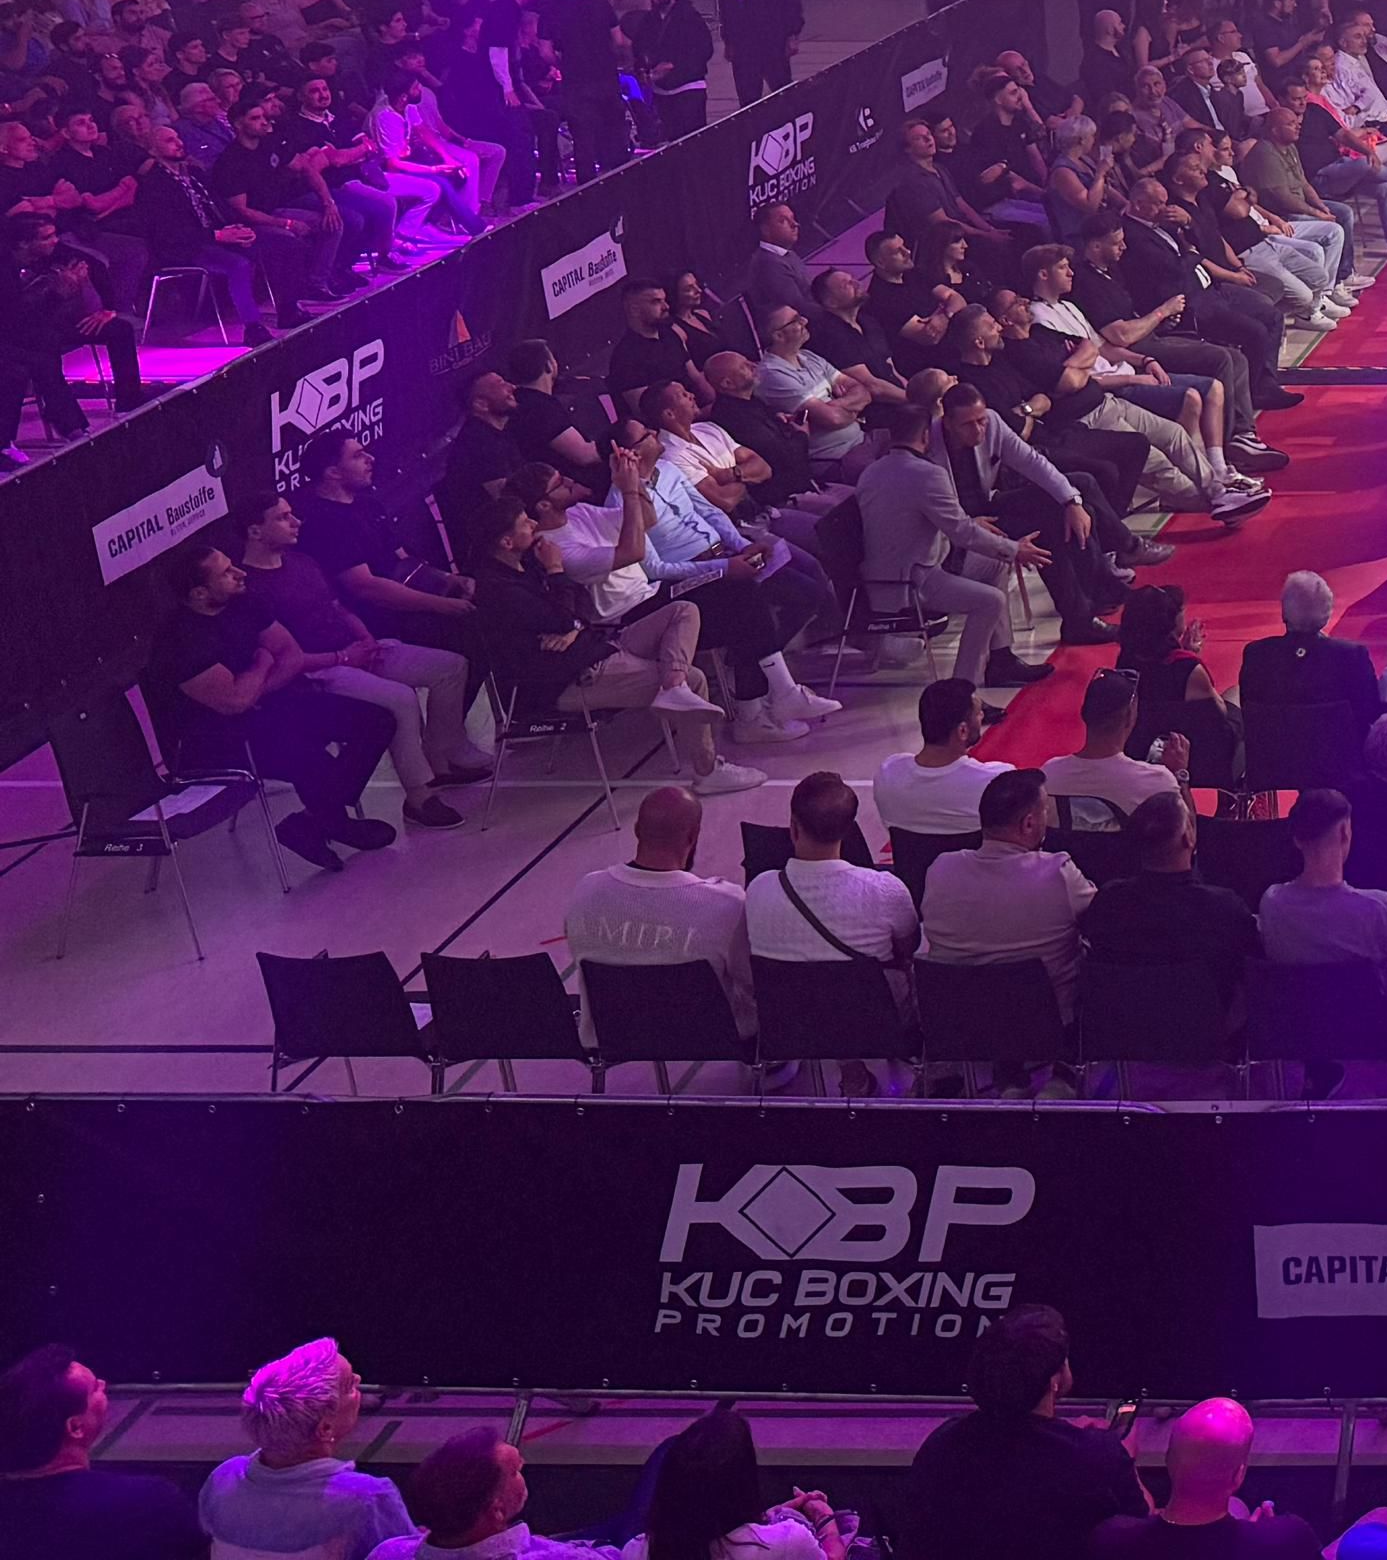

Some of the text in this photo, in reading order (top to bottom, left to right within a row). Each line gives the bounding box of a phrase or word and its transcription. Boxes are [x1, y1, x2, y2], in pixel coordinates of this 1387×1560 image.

[749, 111, 815, 186] KBP
[750, 178, 779, 206] KUC
[551, 267, 585, 298] CAPITAL
[271, 338, 385, 454] KBP
[107, 514, 164, 559] CAPITAL
[166, 485, 216, 527] Baustoffe
[659, 1163, 1036, 1262] KBP
[659, 1269, 1017, 1309] KUC BOXING
